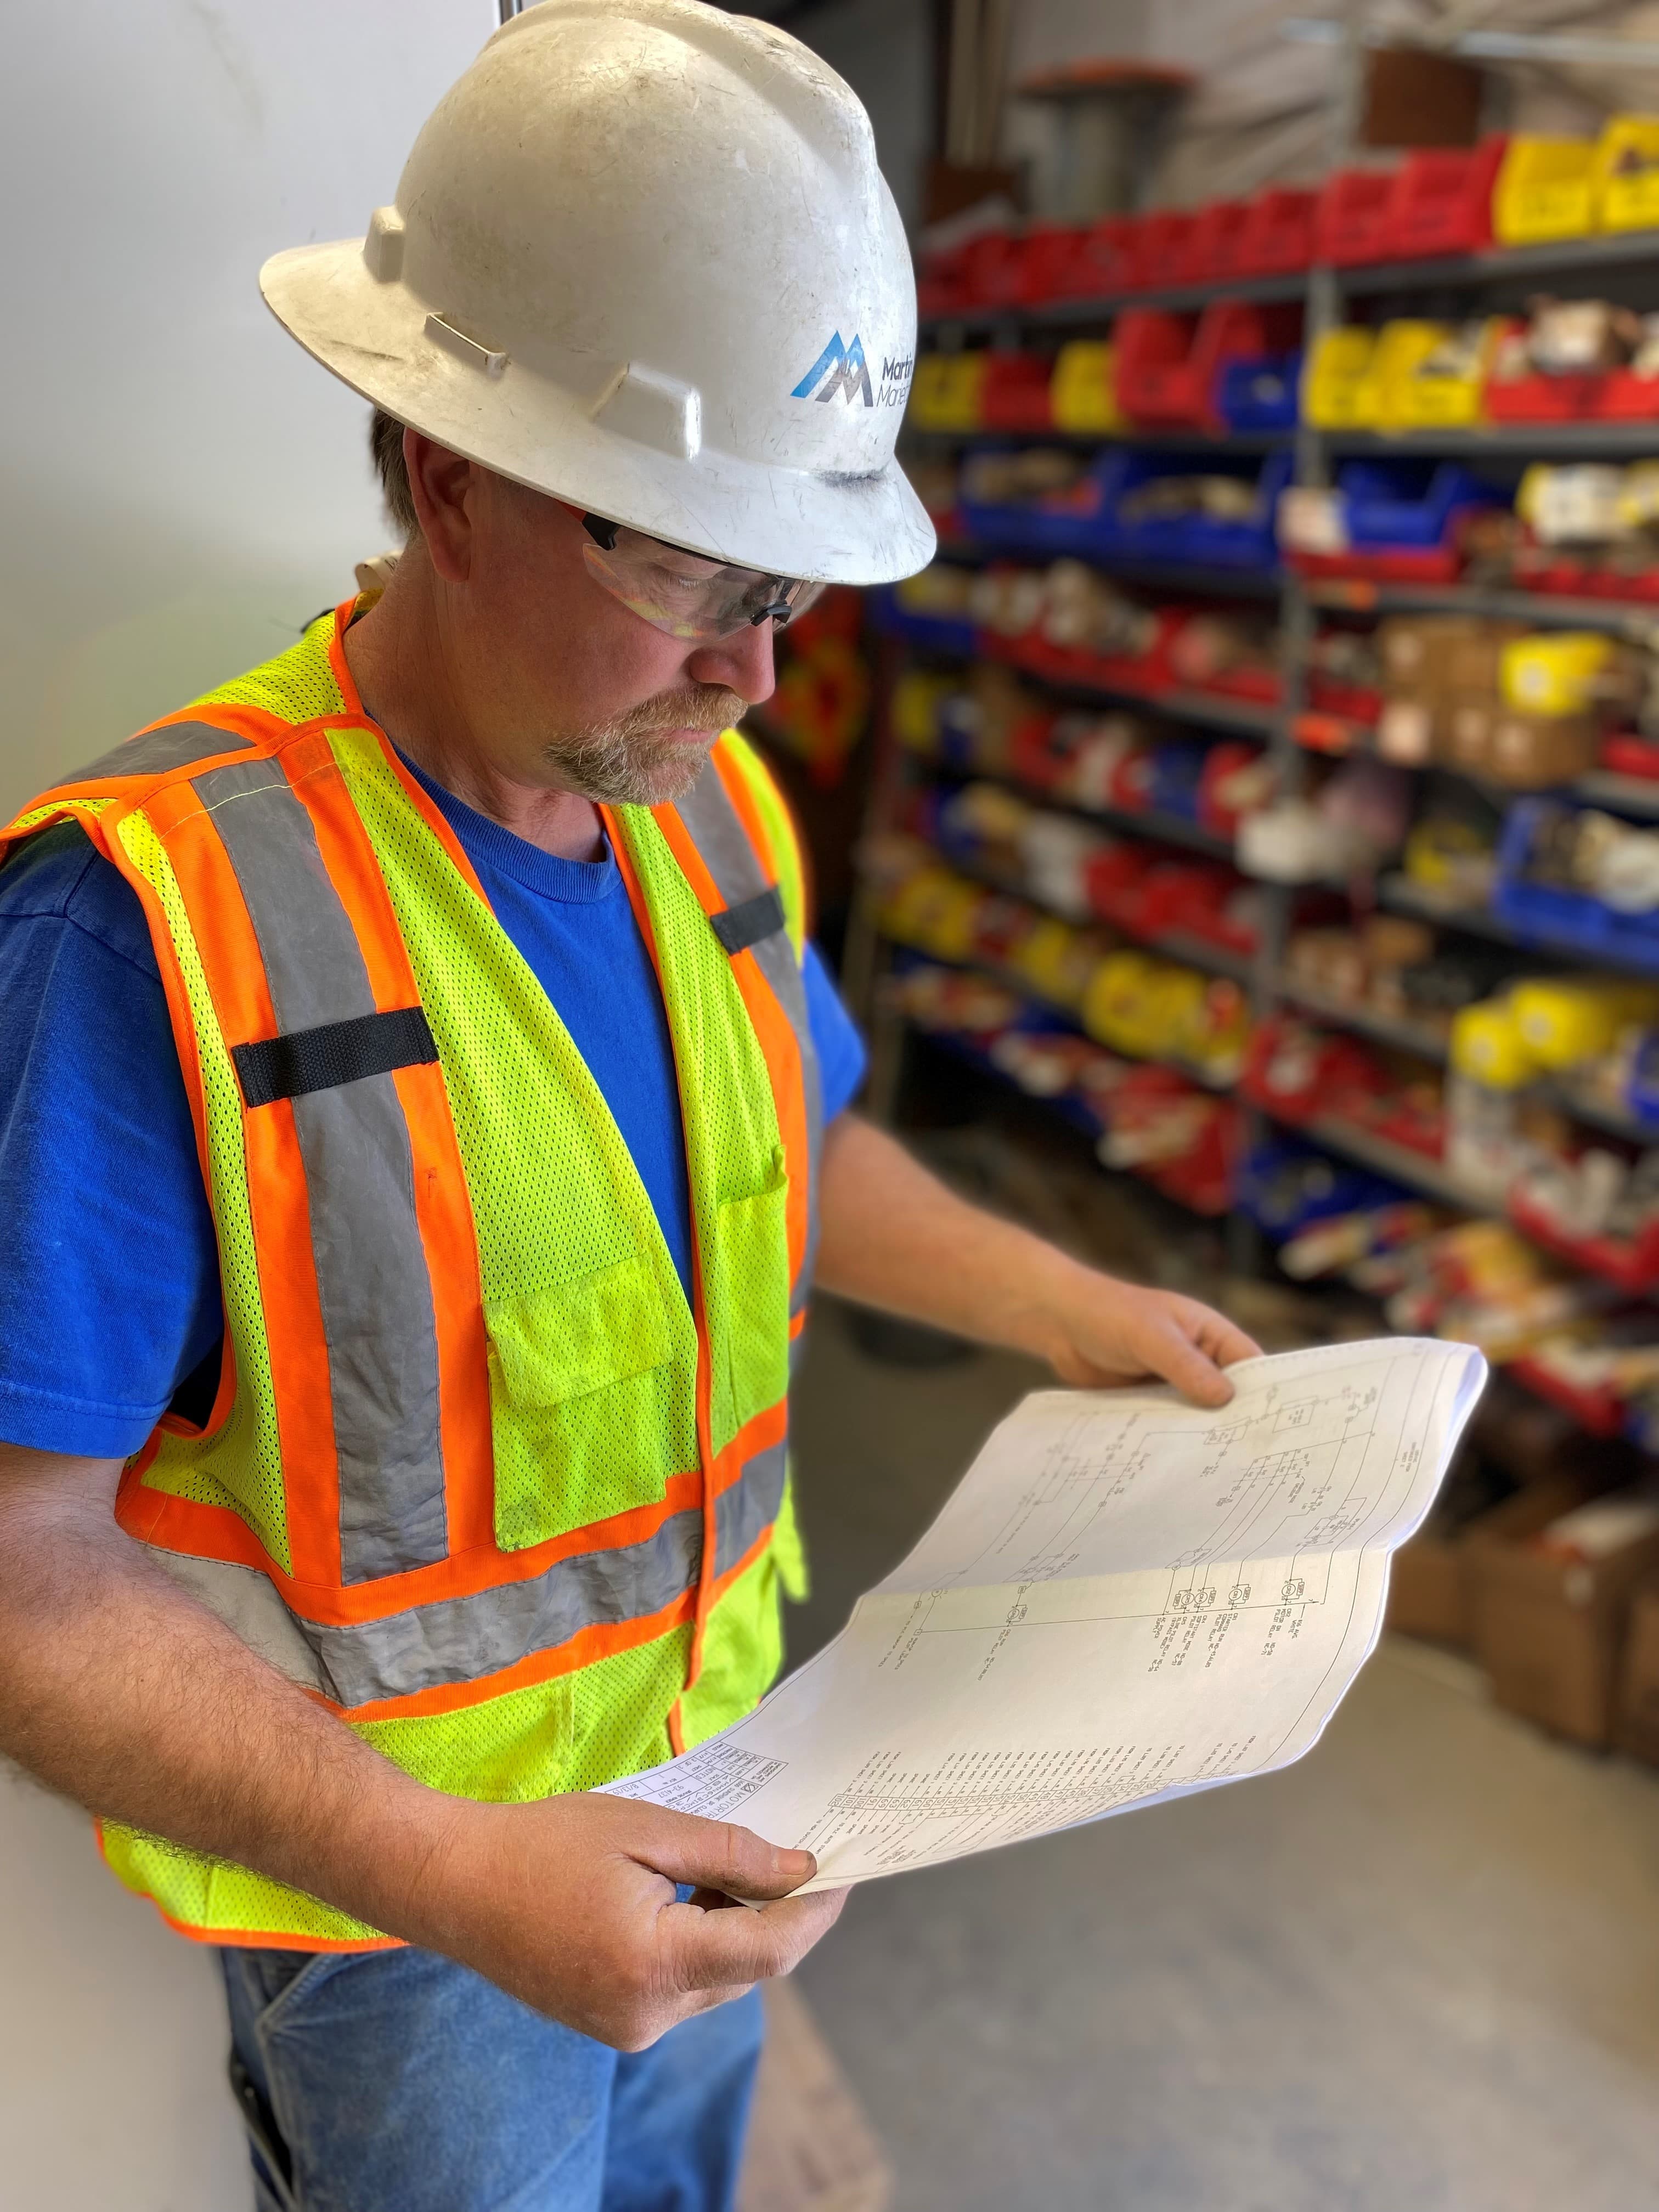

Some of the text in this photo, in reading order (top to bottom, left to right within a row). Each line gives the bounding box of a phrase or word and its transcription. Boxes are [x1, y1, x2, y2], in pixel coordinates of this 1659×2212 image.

[882, 352, 913, 381] Martin
[613, 1784, 639, 1795] 8/13/19
[658, 1785, 684, 1798] 93-4137
[831, 1796, 845, 1807] 102
[842, 1797, 856, 1806] 101
[854, 1798, 866, 1809] 100
[878, 1799, 889, 1808] 69
[889, 1799, 900, 1808] 63
[900, 1799, 911, 1808] 62
